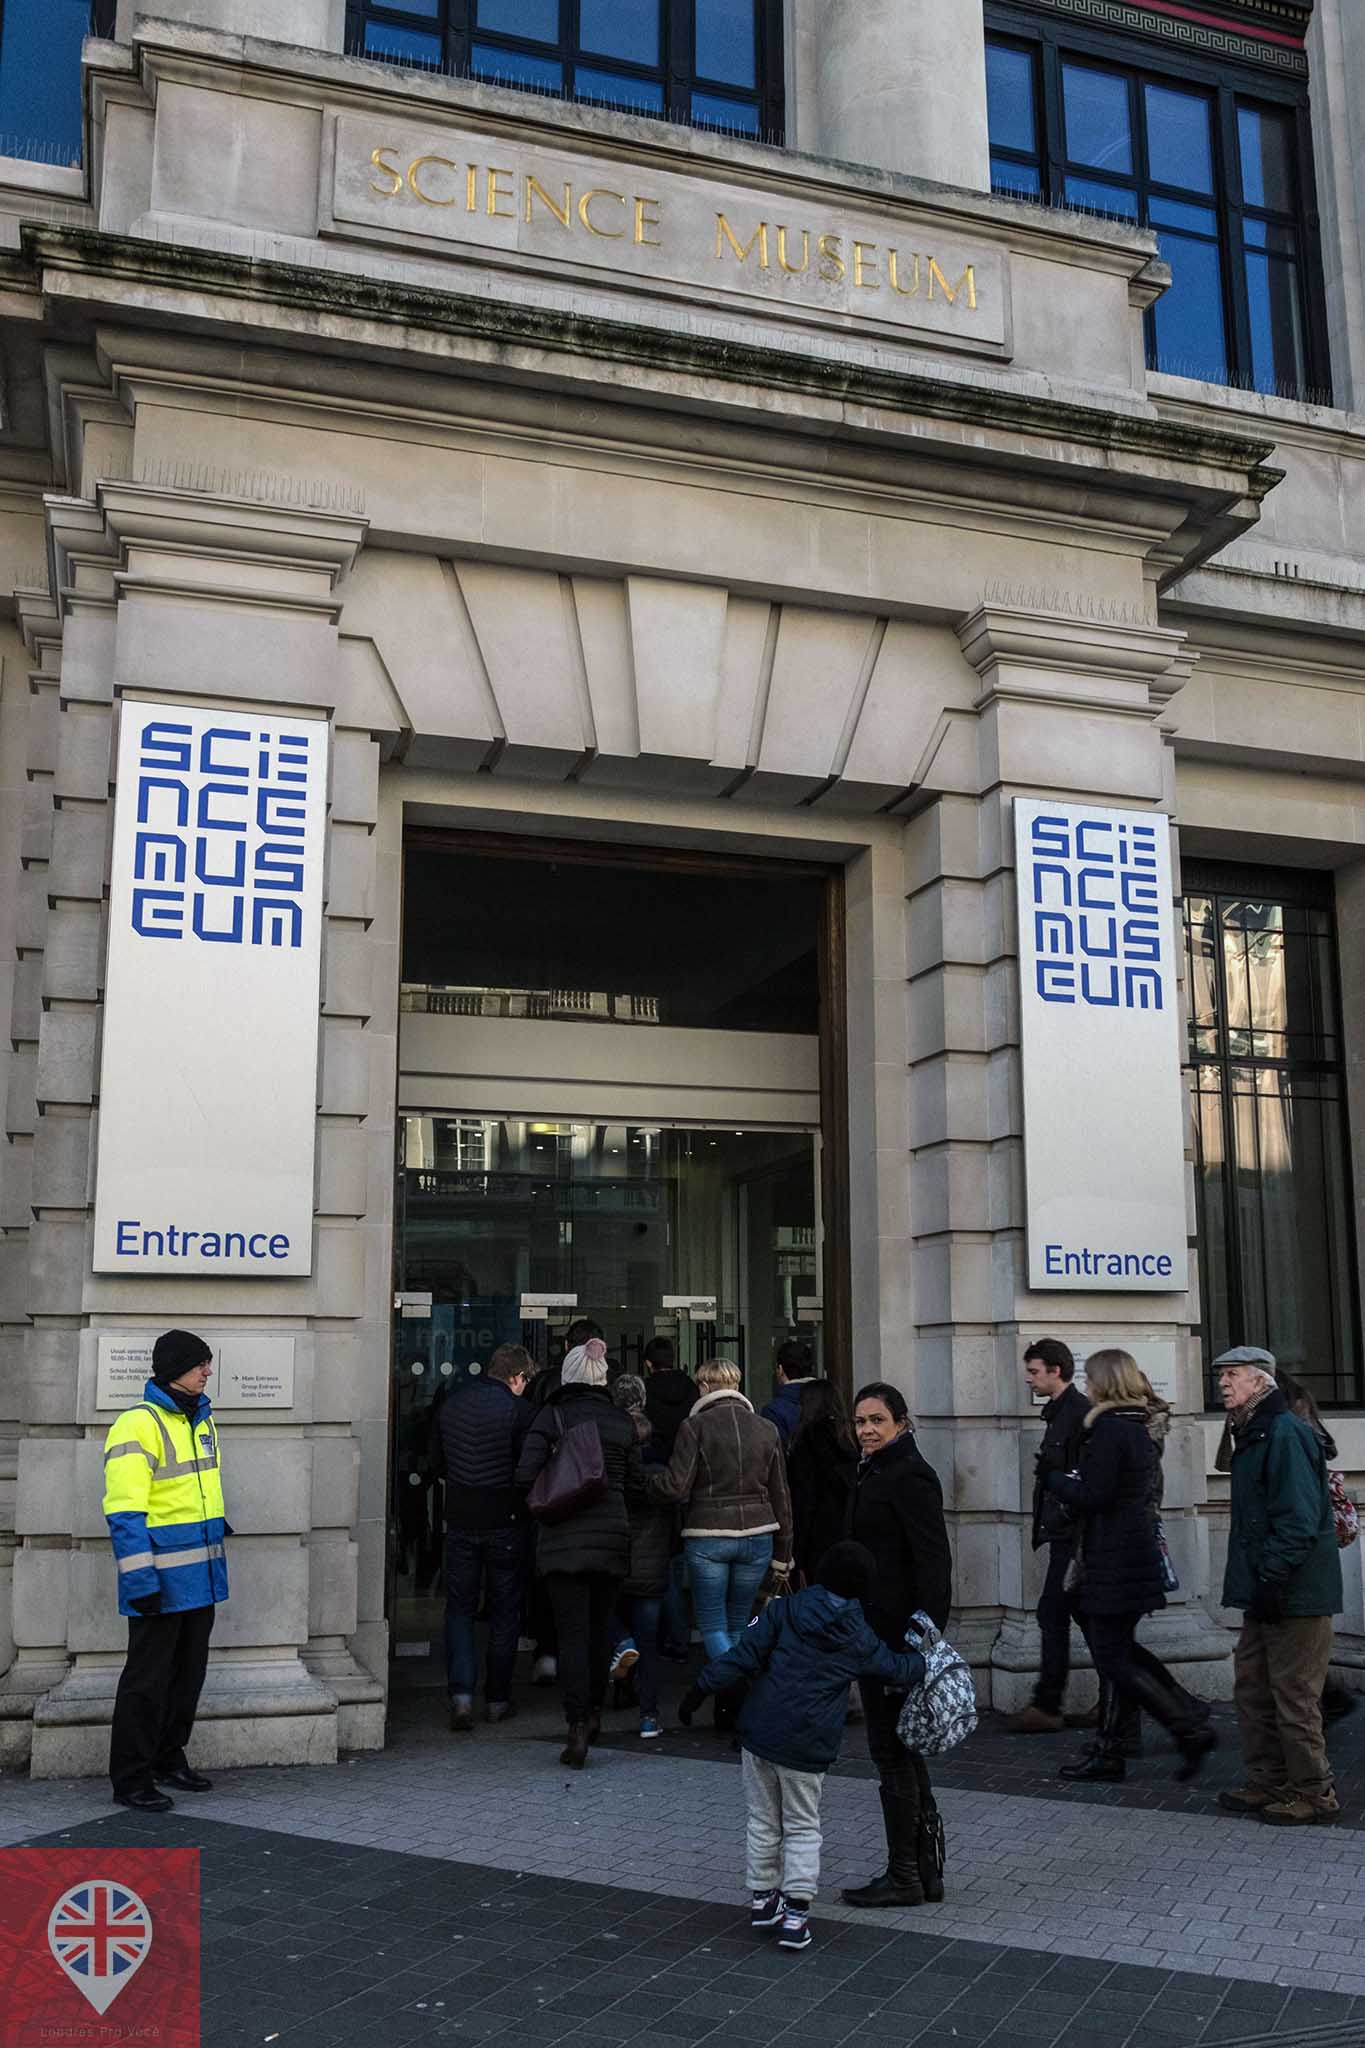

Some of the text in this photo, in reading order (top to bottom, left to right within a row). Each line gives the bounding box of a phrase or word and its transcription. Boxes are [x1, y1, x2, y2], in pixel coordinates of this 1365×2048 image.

[368, 147, 977, 309] SCIENCE MUSEUM
[115, 1220, 291, 1259] Entrance
[1045, 1244, 1173, 1276] Entrance
